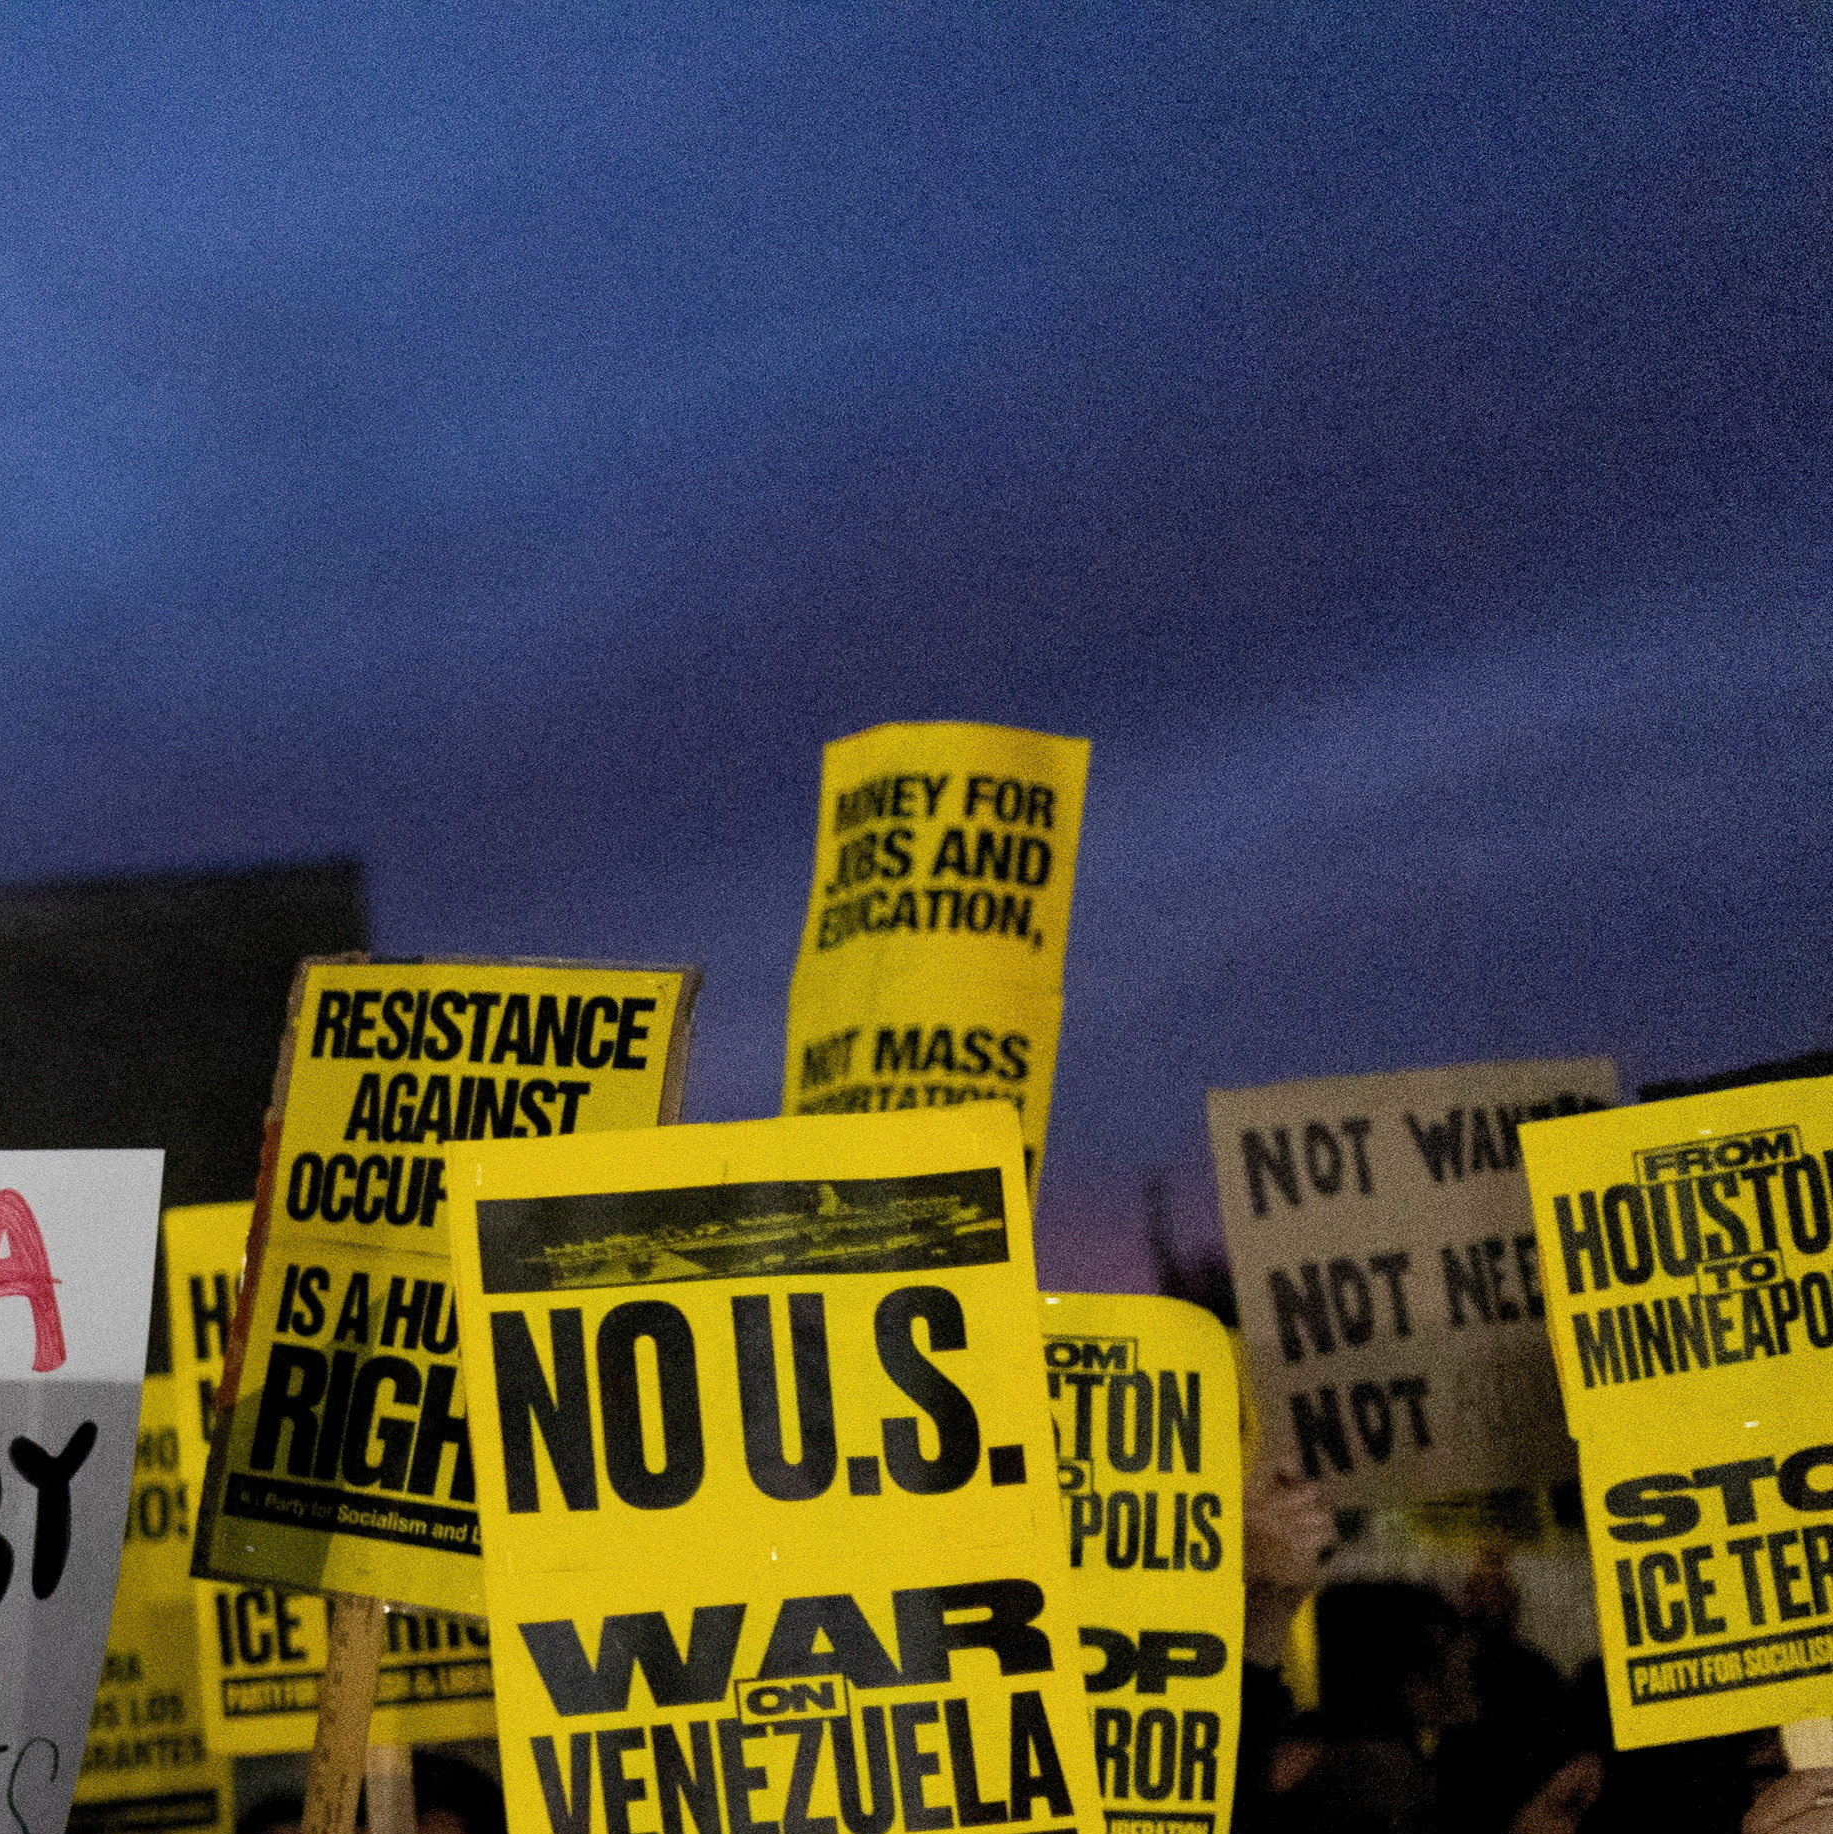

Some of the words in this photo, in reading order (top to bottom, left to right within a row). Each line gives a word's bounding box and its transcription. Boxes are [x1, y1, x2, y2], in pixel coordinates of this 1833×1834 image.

[963, 775, 1056, 830] FOR
[932, 827, 1052, 888] AND
[310, 989, 658, 1074] RESISTANCE
[873, 1023, 1033, 1082] MASS
[344, 1071, 591, 1144] AGAINST
[1240, 1118, 1372, 1219] NOT
[1644, 1132, 1794, 1182] FROM
[1553, 1150, 1833, 1296] HOUSTO
[277, 1264, 330, 1335] IS
[335, 1271, 370, 1341] A
[1266, 1252, 1411, 1366] NOT
[1703, 1256, 1778, 1290] TO
[1571, 1270, 1833, 1390] MINNEAPO
[247, 1343, 476, 1504] RIGH
[489, 1298, 706, 1514] NO
[731, 1285, 1027, 1502] U.S.
[1289, 1377, 1432, 1482] NOT
[336, 1502, 428, 1536] Socialism
[430, 1523, 469, 1544] and
[1068, 1490, 1224, 1572] POLIS
[1604, 1444, 1833, 1544] STO
[1615, 1545, 1728, 1648] ICE
[1726, 1524, 1833, 1627] TER
[216, 1589, 307, 1668] ICE
[518, 1578, 1055, 1718] WAR
[747, 1680, 836, 1716] ON
[1633, 1659, 1703, 1697] PARTY
[1701, 1651, 1744, 1687] FOR
[1093, 1705, 1221, 1804] ROR
